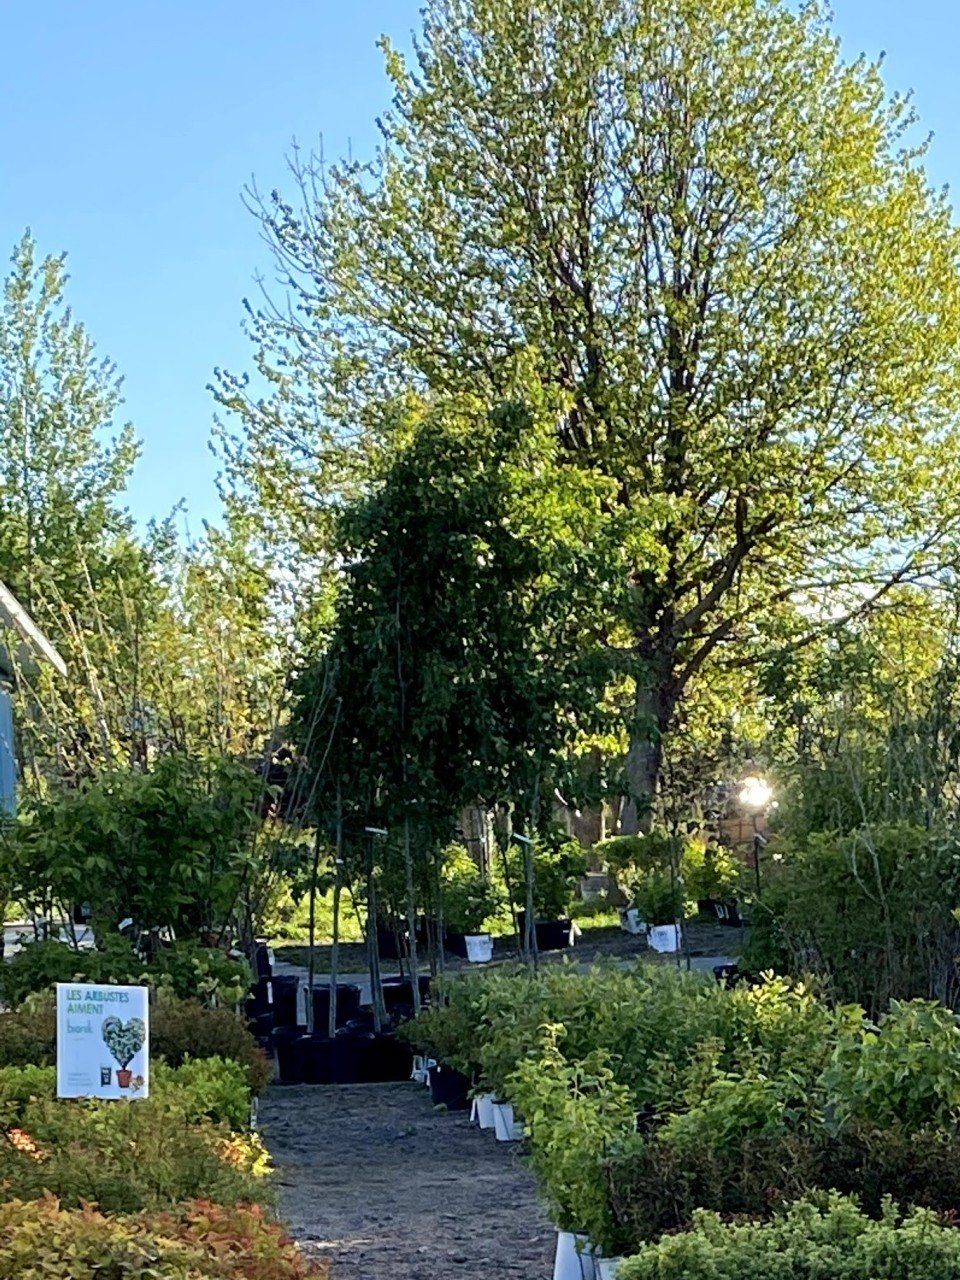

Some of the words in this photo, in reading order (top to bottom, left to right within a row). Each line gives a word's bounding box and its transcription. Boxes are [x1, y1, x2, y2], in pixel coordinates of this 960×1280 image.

[66, 990, 81, 1001] LES
[84, 991, 129, 1003] ARBUSTES
[67, 1004, 103, 1015] AIMENT
